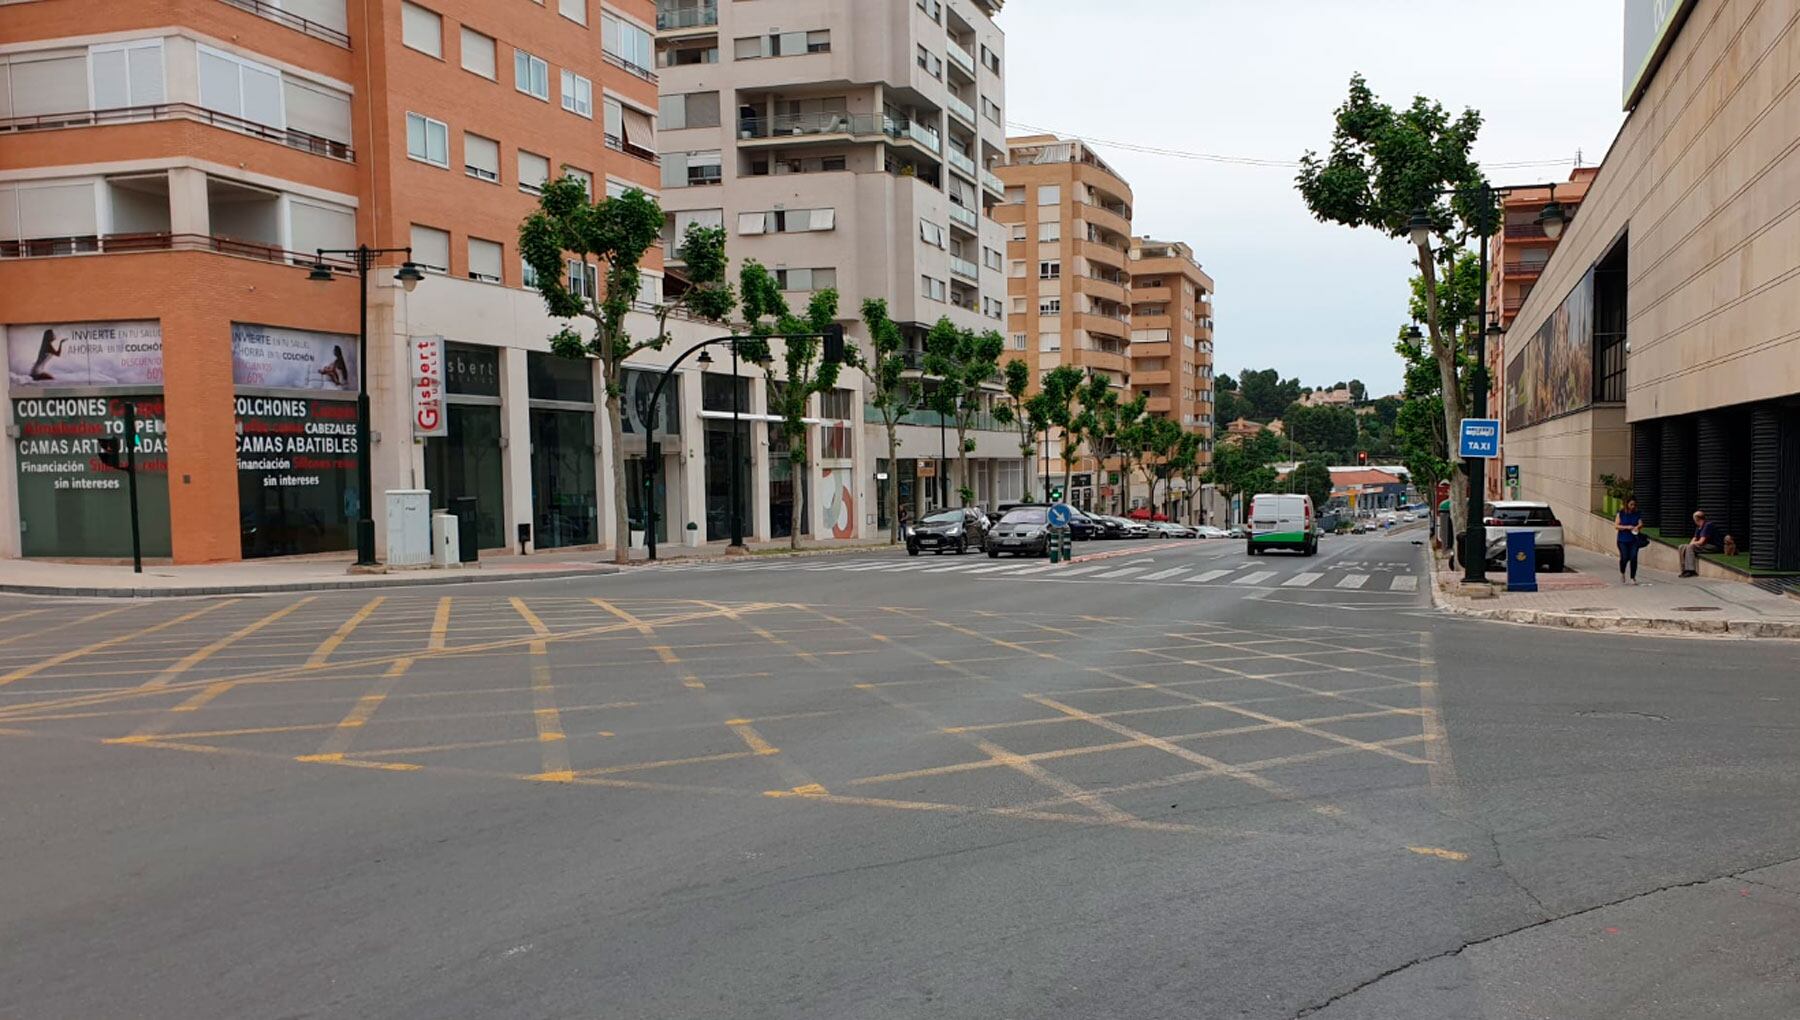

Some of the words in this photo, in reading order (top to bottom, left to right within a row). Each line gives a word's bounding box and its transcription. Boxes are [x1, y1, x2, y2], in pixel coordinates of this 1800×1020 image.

[72, 329, 116, 340] INVIERTE
[234, 331, 272, 346] NVIERTE
[67, 344, 104, 355] AHORRA
[282, 352, 315, 362] COLCHÓN
[417, 341, 440, 430] Gisbert
[17, 399, 107, 418] COLCHONES
[104, 419, 164, 435] TOPE
[304, 422, 358, 436] CABEZALES
[19, 438, 69, 455] CAMAS
[286, 436, 359, 454] ABATIBLES
[1467, 442, 1491, 451] TAXI
[20, 459, 85, 473] Financiación
[54, 477, 70, 489] sin
[71, 477, 121, 489] intereses
[263, 474, 278, 486] sin
[279, 474, 320, 486] intereses
